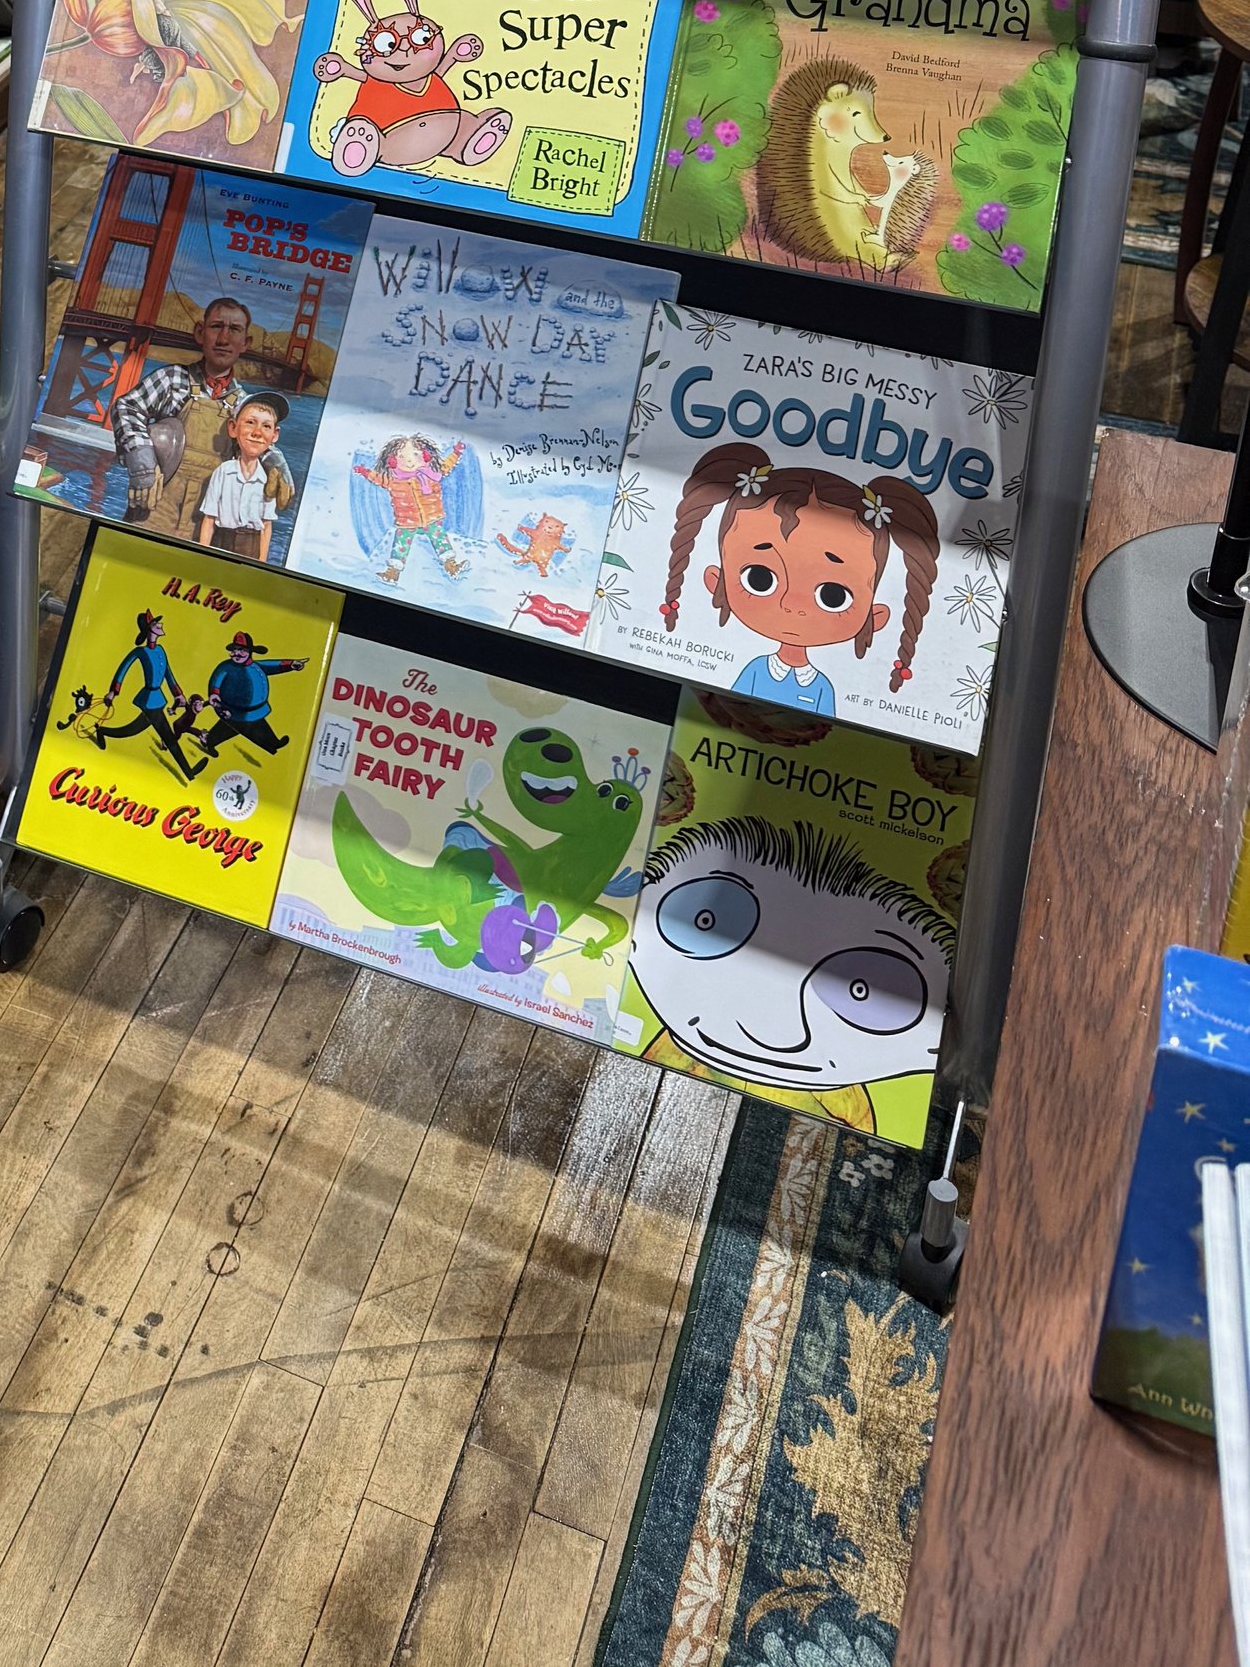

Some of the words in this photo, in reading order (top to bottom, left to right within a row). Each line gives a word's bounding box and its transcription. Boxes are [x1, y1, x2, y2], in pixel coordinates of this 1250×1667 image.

[499, 10, 627, 51] Super
[463, 60, 630, 101] Spectacles
[886, 64, 919, 76] Brenna
[922, 68, 962, 83] Vaughan
[892, 51, 919, 63] David
[922, 55, 960, 69] Bedford
[534, 139, 606, 173] Rachel
[220, 189, 239, 199] EVE
[243, 192, 289, 210] BUNTING
[531, 168, 600, 199] Bright
[222, 209, 309, 242] POP'S
[227, 232, 353, 273] BRIDGE
[381, 302, 513, 350] SNOW
[530, 314, 618, 364] DAY
[408, 351, 573, 418] DANCE
[743, 353, 813, 378] ZARA'S
[822, 363, 858, 386] BIG
[866, 374, 939, 410] MESSY
[671, 366, 994, 500] Goodbye
[203, 589, 242, 622] Rey
[631, 627, 682, 650] REBEKAH
[686, 639, 734, 662] BORUCKI
[402, 669, 438, 696] The
[333, 678, 497, 747] DINOSAUR
[352, 717, 464, 770] TOOTH
[353, 752, 445, 799] FAIRY
[690, 737, 876, 812] ARTICHOKE
[889, 789, 958, 832] BOY
[49, 767, 159, 827] Curious
[161, 804, 263, 868] George
